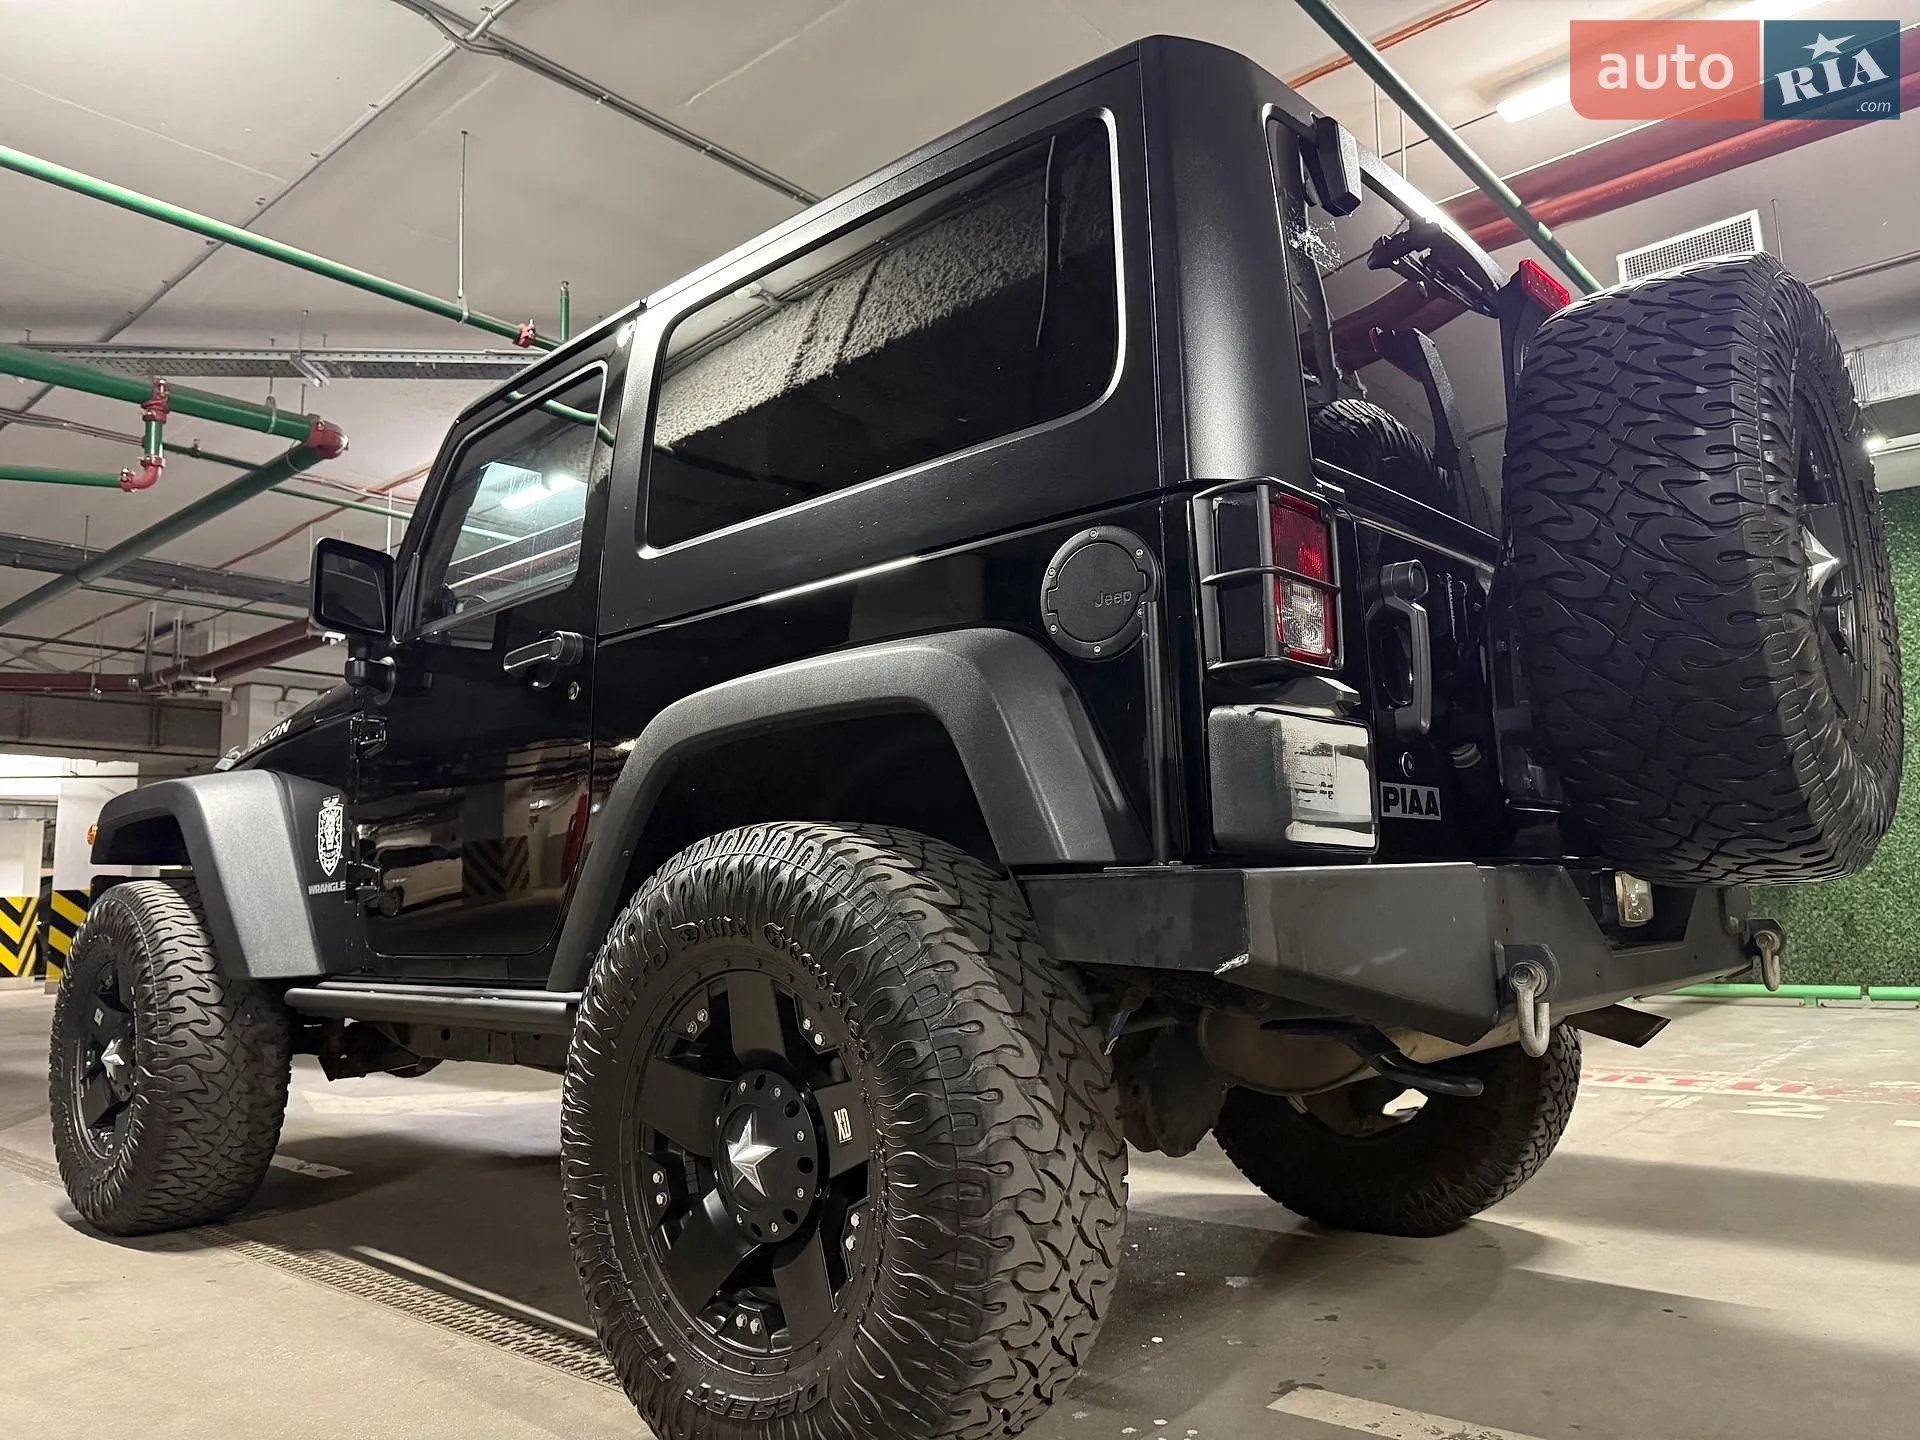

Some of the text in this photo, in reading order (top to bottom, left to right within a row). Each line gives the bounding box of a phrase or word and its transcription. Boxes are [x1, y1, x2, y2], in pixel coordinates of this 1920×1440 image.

[1095, 591, 1132, 608] Jeep
[1383, 786, 1440, 817] PIAA
[308, 881, 346, 895] WRANGLE
[834, 1108, 852, 1140] XD
